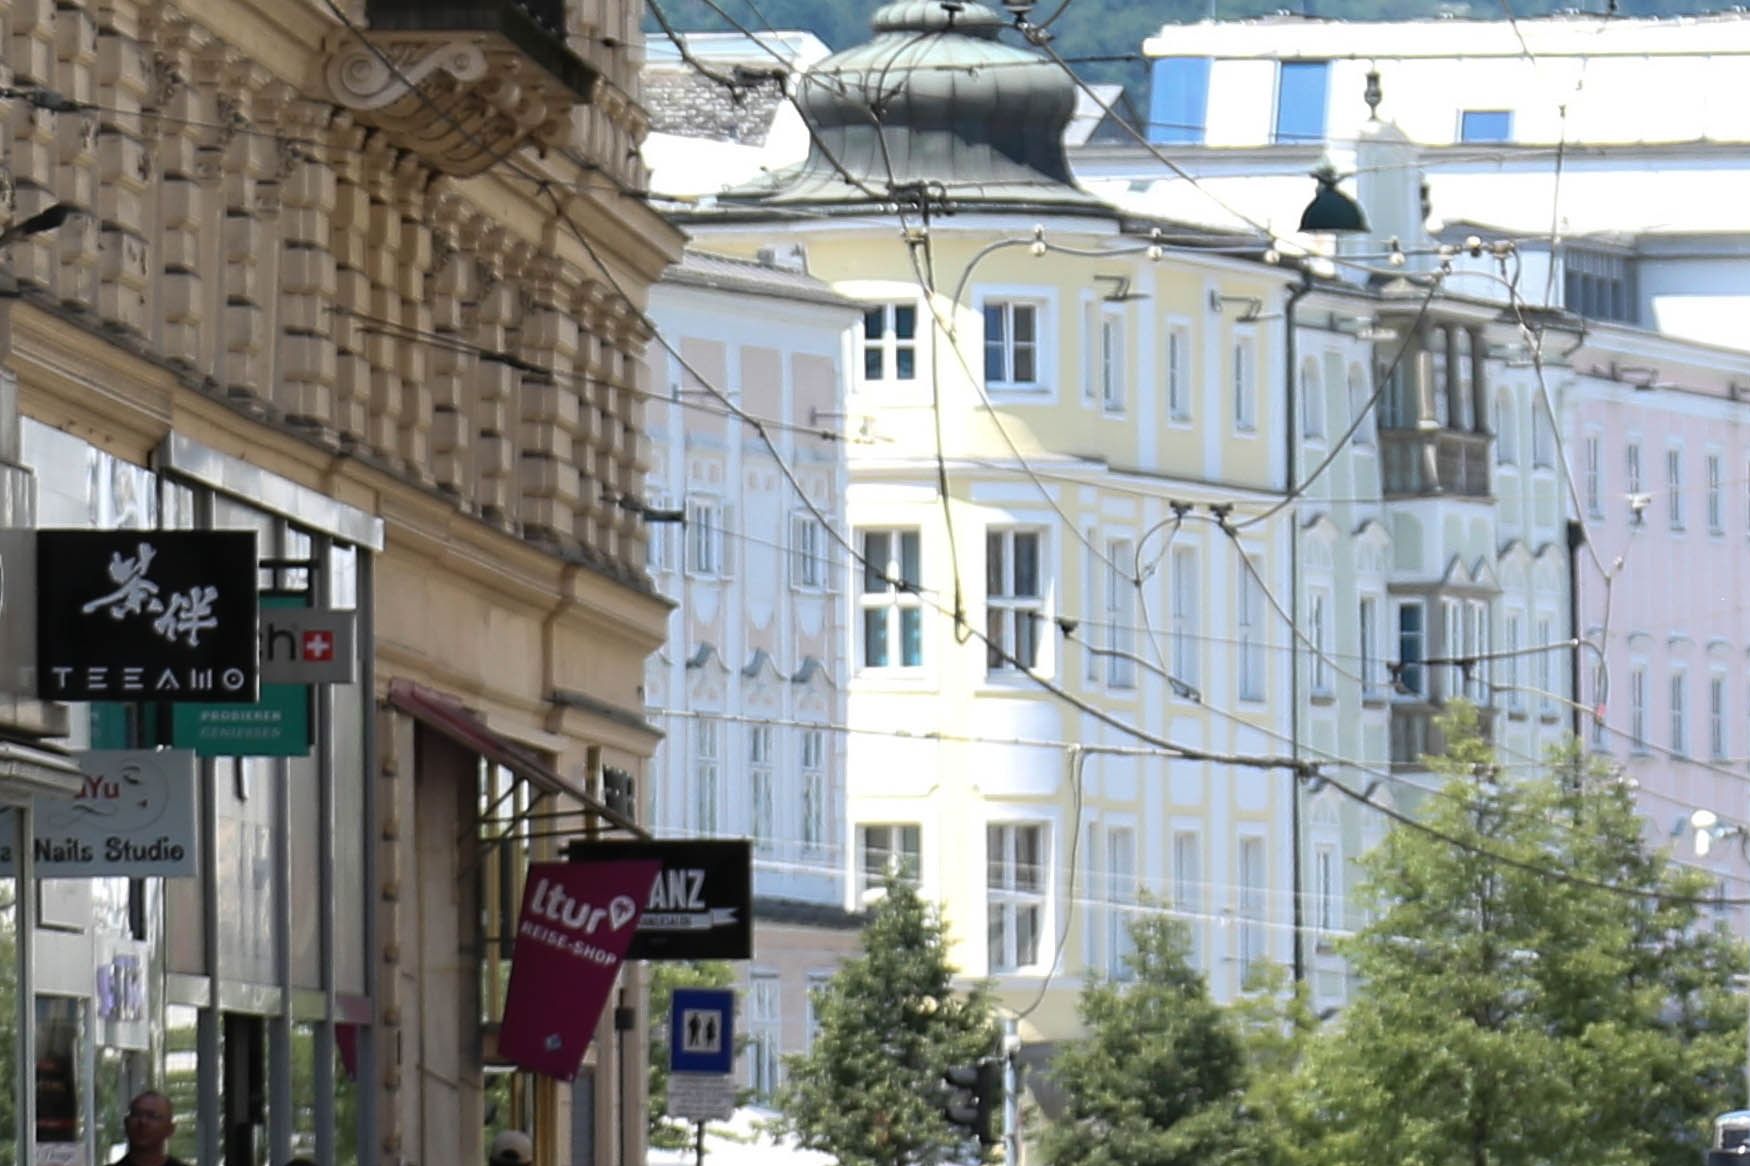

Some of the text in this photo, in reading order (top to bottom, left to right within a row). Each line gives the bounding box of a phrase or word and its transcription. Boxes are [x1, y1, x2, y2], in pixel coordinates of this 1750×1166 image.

[52, 667, 245, 691] TEEAMO
[34, 837, 94, 864] Nails
[105, 836, 185, 863] Studio
[520, 920, 618, 967] REISE-SHOP
